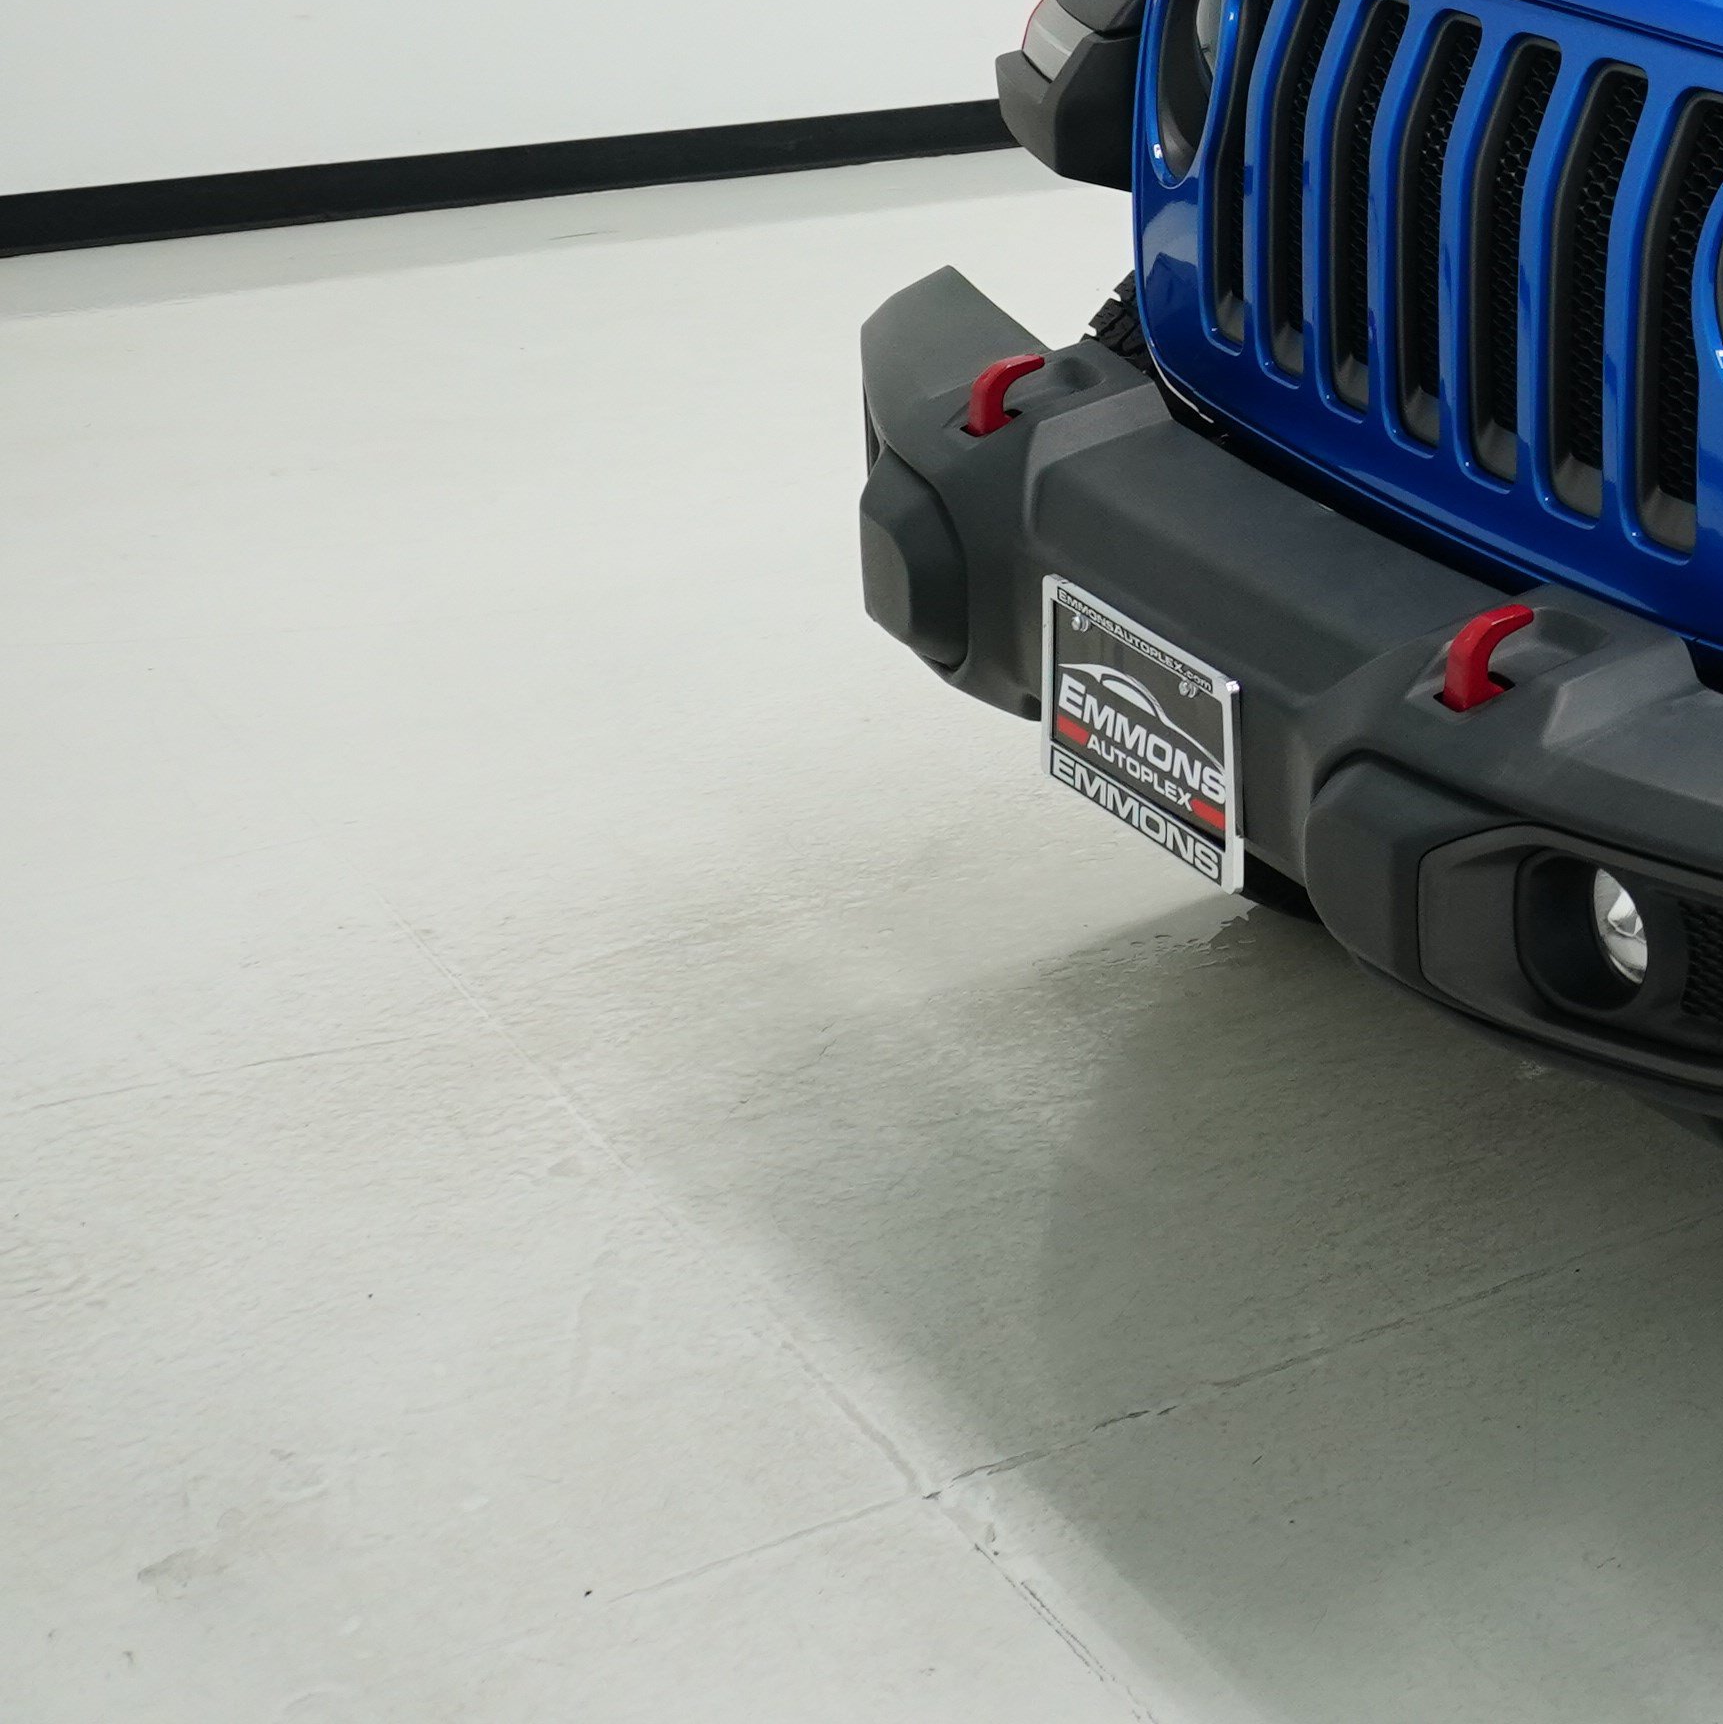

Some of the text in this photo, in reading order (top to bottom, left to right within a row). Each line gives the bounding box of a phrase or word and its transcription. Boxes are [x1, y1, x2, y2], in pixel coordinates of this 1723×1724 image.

[1058, 673, 1227, 805] EMMONS
[1086, 733, 1193, 812] AUTOPLEX
[1052, 754, 1219, 881] EMMONS
